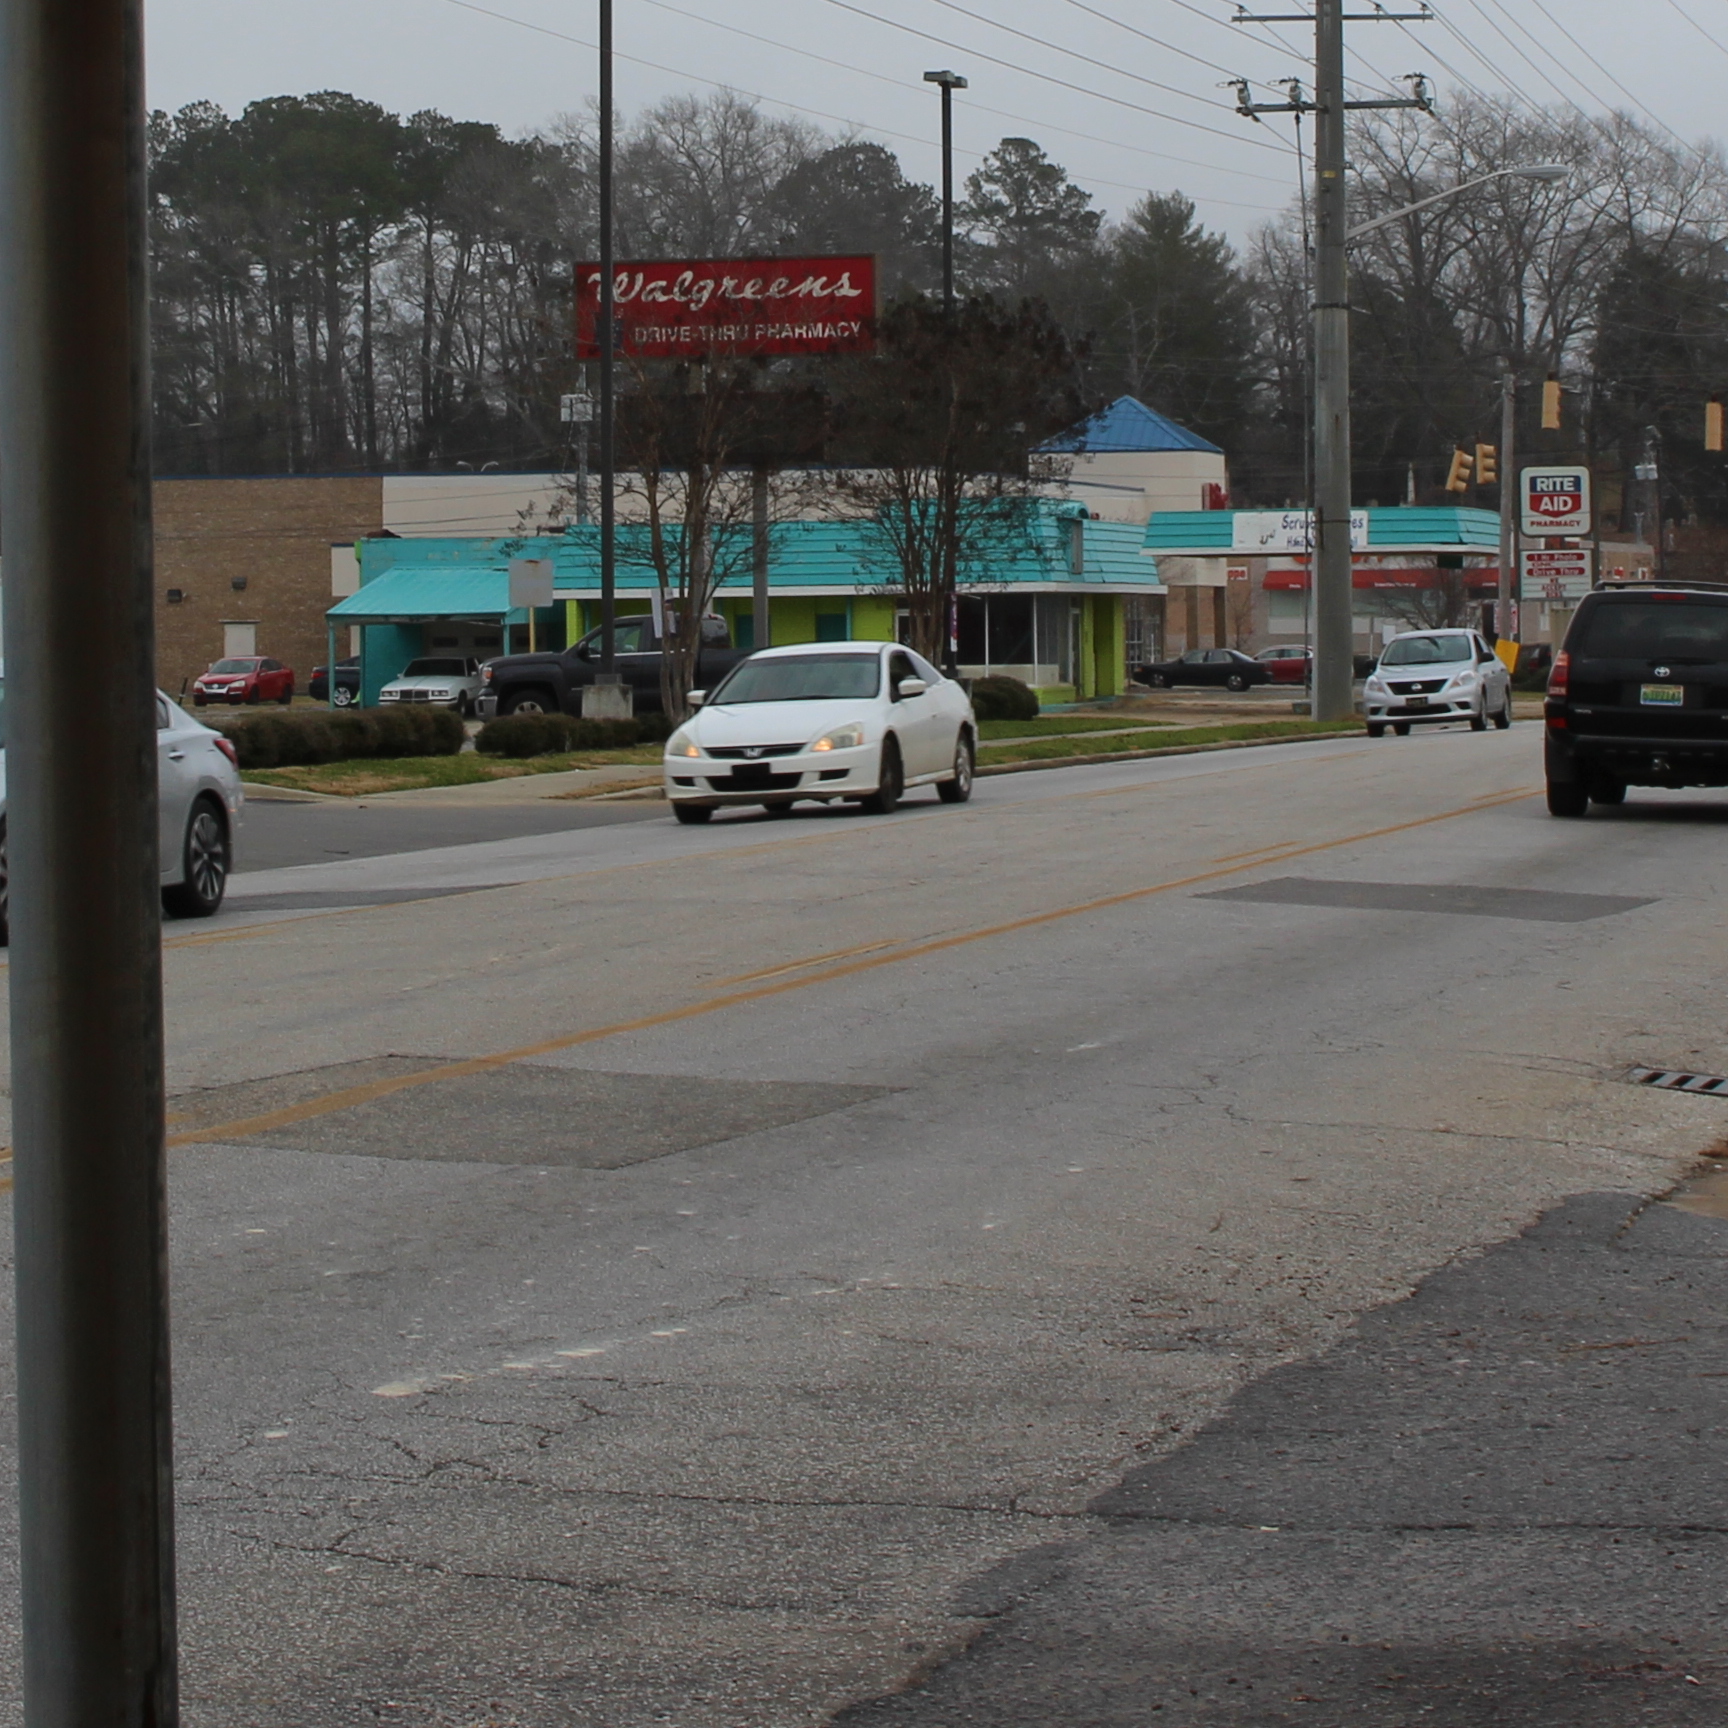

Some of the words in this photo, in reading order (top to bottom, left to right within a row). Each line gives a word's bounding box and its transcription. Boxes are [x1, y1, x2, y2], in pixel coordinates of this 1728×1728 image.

[587, 270, 863, 312] Walgreens
[634, 324, 749, 343] DRIVE-THRU
[754, 321, 862, 340] PHARMACY
[1536, 477, 1575, 492] RITE
[1539, 496, 1573, 512] AID
[1529, 519, 1581, 528] PHARMACY
